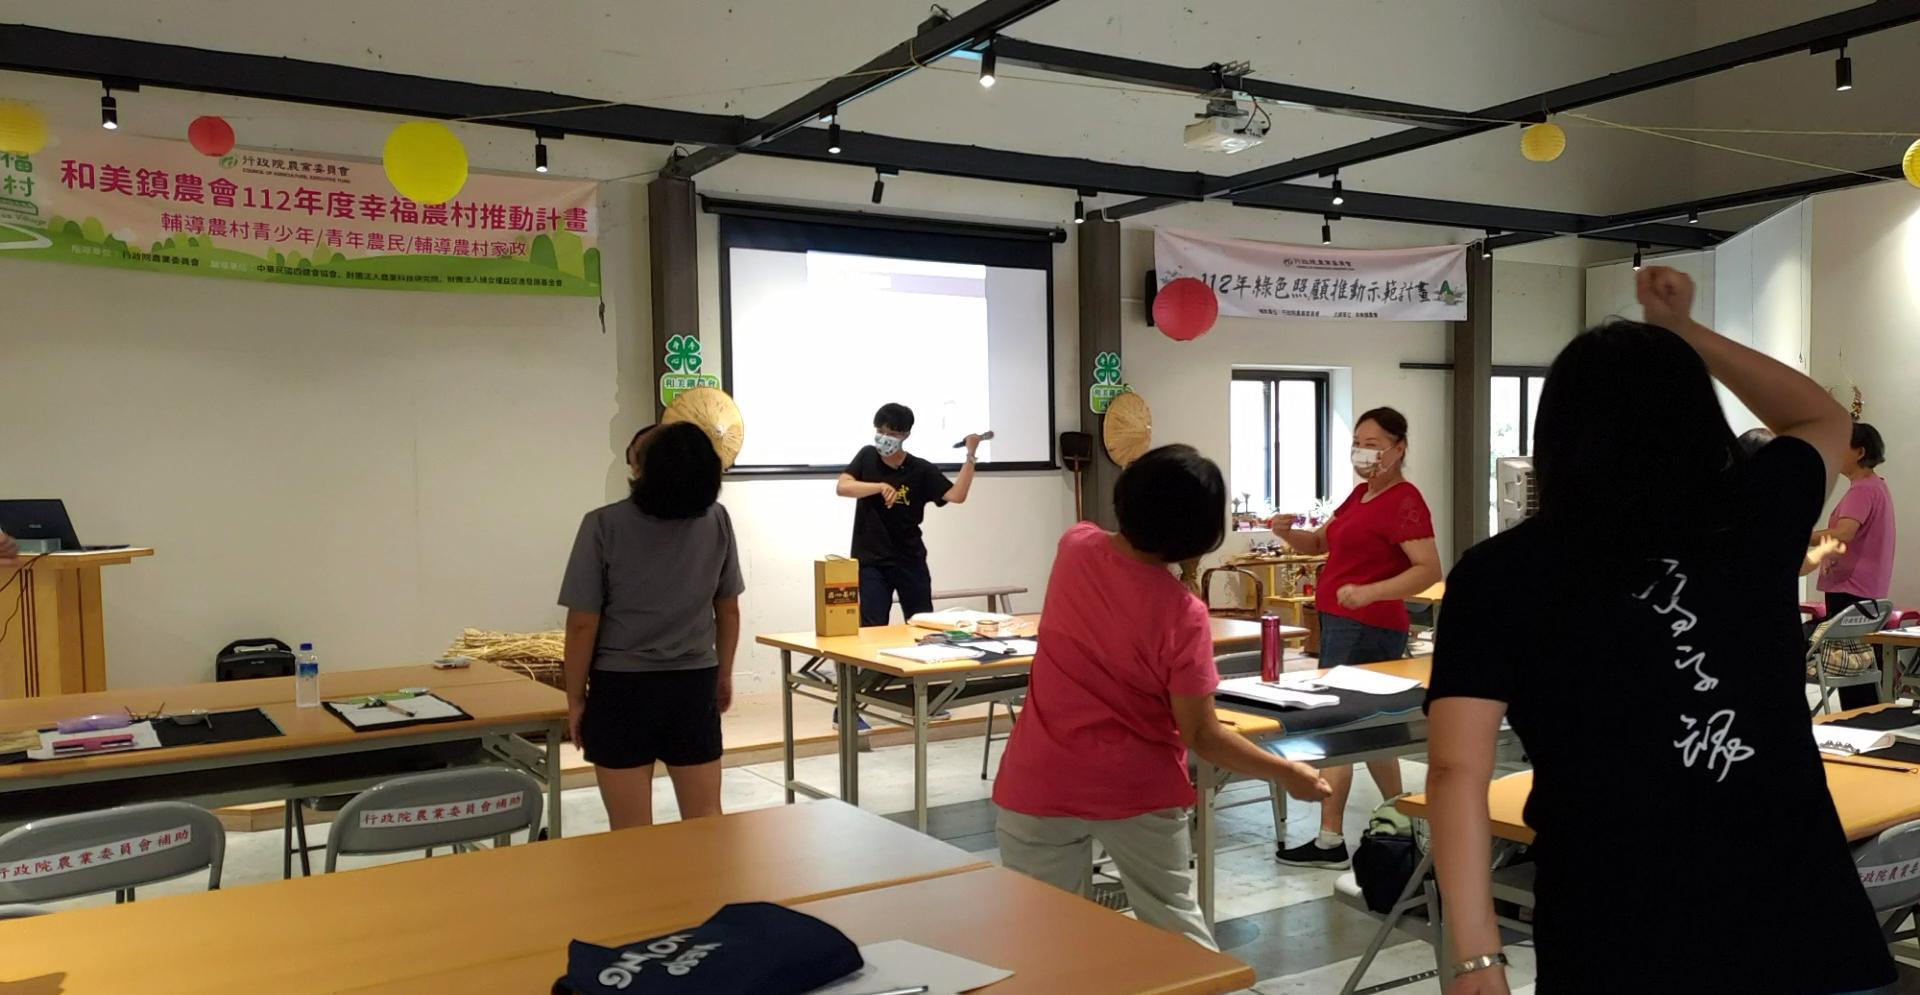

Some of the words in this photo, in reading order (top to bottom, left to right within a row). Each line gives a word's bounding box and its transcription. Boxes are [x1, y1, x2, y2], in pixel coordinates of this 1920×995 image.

[242, 155, 350, 176] 行政院農業委員會
[3, 175, 35, 197] 村
[61, 159, 588, 232] 和美鎮農會112年度幸福農村推動計畫
[364, 795, 521, 825] 行政院農業委員會補助
